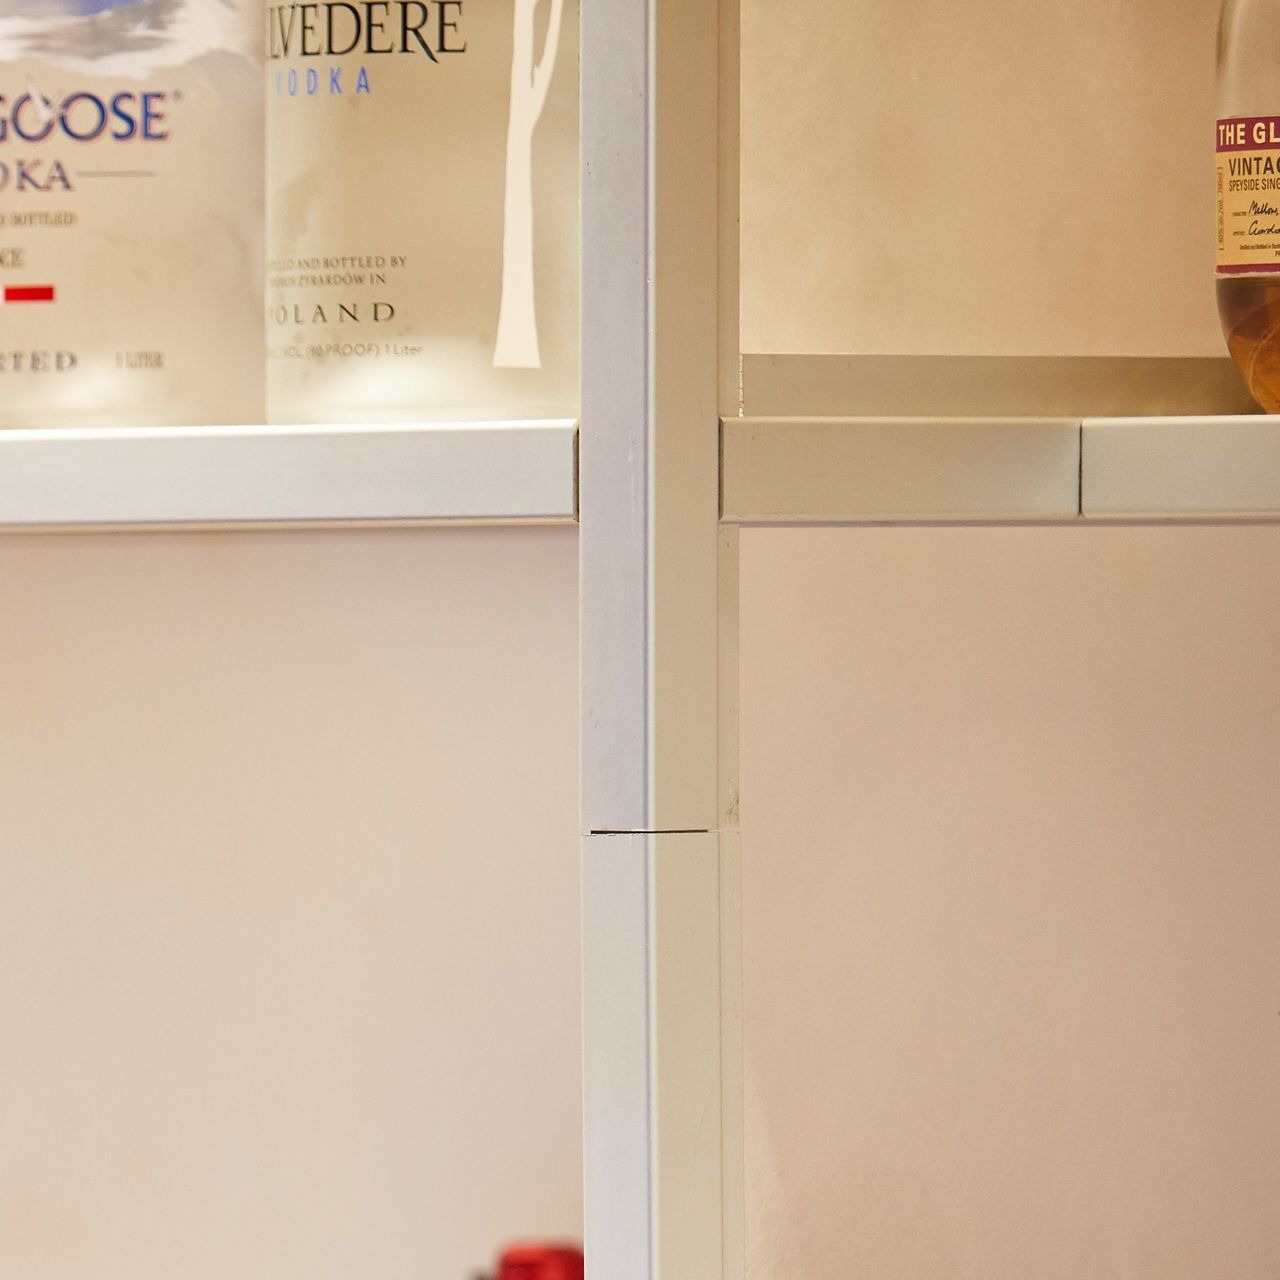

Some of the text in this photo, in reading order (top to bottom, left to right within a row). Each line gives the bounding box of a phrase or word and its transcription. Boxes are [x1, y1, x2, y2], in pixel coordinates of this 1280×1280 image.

[1218, 123, 1246, 146] THE
[1228, 179, 1260, 192] SPEYSIDE
[323, 256, 386, 269] BOTTLED
[390, 256, 406, 268] BY
[369, 273, 386, 285] IN
